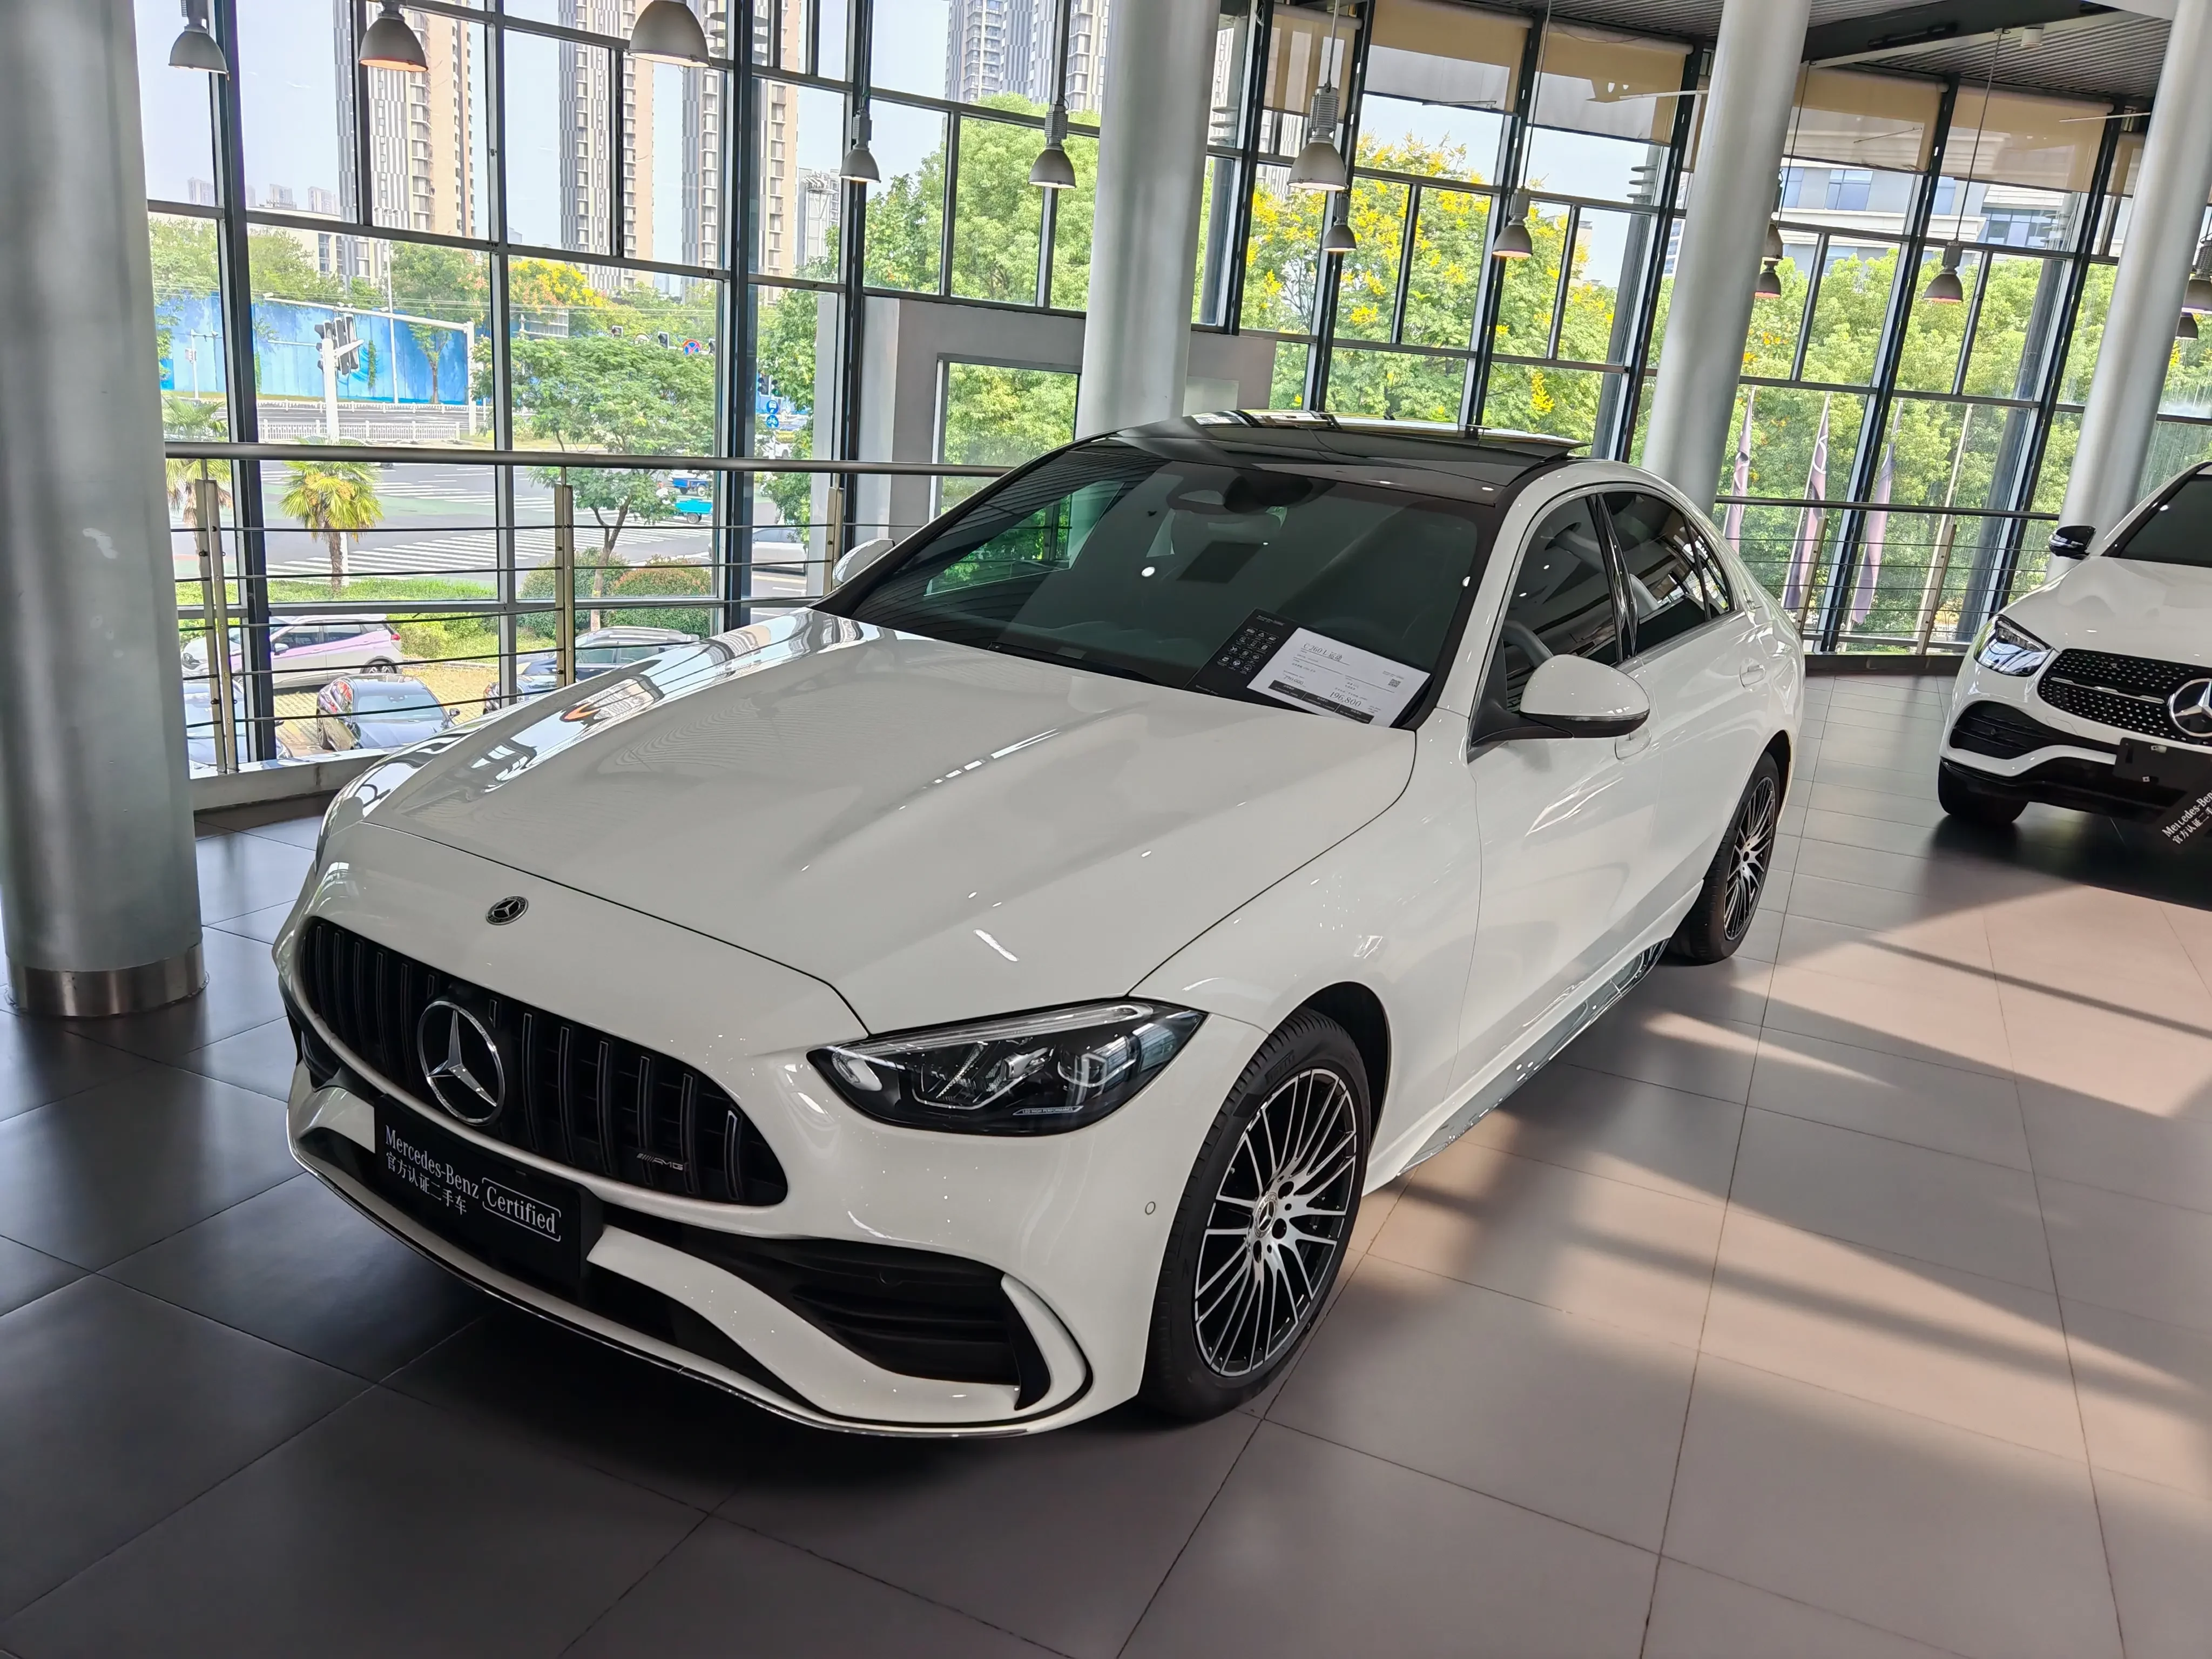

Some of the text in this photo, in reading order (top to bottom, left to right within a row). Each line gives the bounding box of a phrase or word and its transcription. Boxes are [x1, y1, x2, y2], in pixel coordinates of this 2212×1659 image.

[1308, 645, 1323, 653] 260
[1329, 692, 1361, 707] 196,800
[2162, 790, 2212, 838] Mercedes-Ben
[385, 1124, 556, 1234] Mercedes-Benz Certified
[652, 1157, 684, 1171] AMG
[386, 1151, 467, 1215] 官方认证二手车
